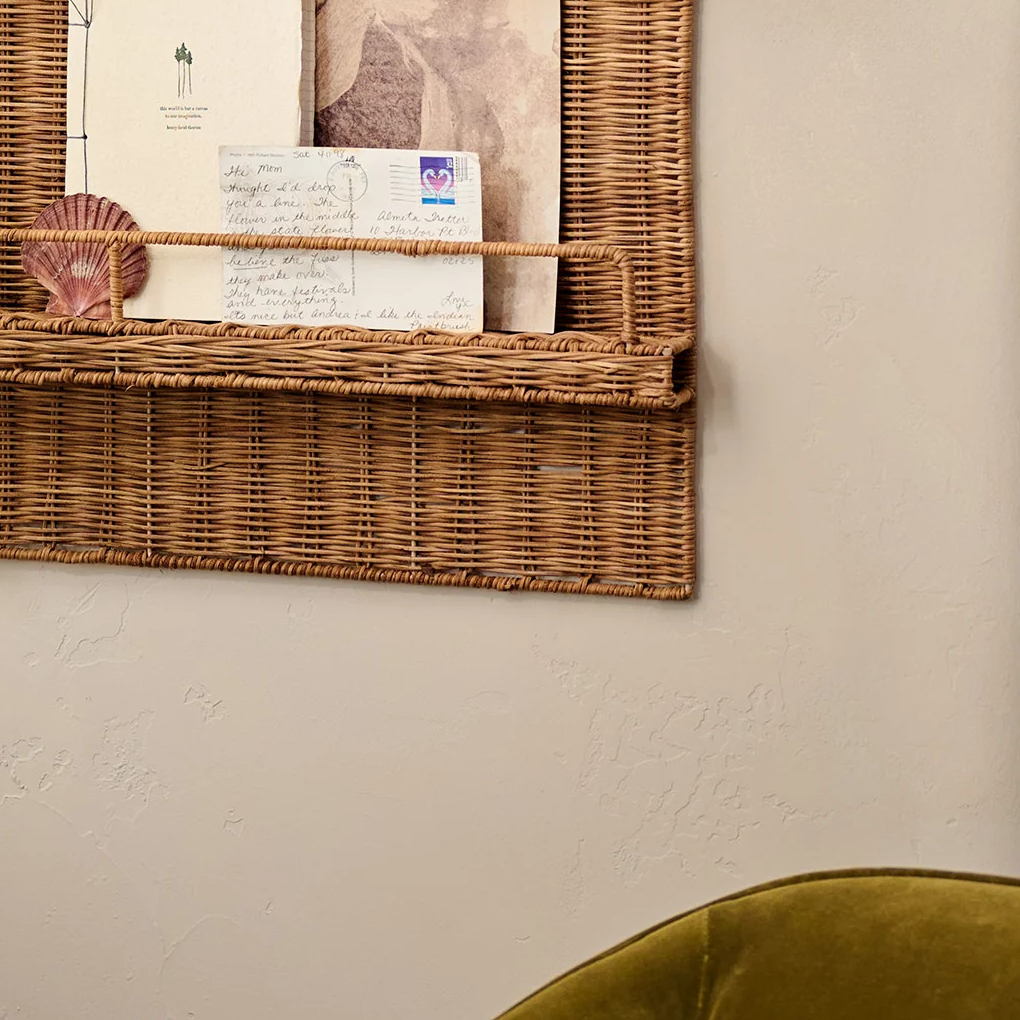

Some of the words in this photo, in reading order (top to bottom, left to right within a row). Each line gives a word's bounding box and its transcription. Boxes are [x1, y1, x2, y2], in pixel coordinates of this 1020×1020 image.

[257, 164, 283, 175] Mom
[307, 181, 337, 196] drop
[254, 199, 267, 208] a
[312, 196, 339, 208] The
[271, 215, 290, 223] in
[291, 211, 315, 223] the
[282, 254, 305, 265] the
[256, 269, 291, 282] make
[226, 297, 257, 309] and
[250, 313, 278, 321] nice
[282, 309, 304, 320] but
[376, 307, 400, 319] like
[403, 309, 423, 320] the
